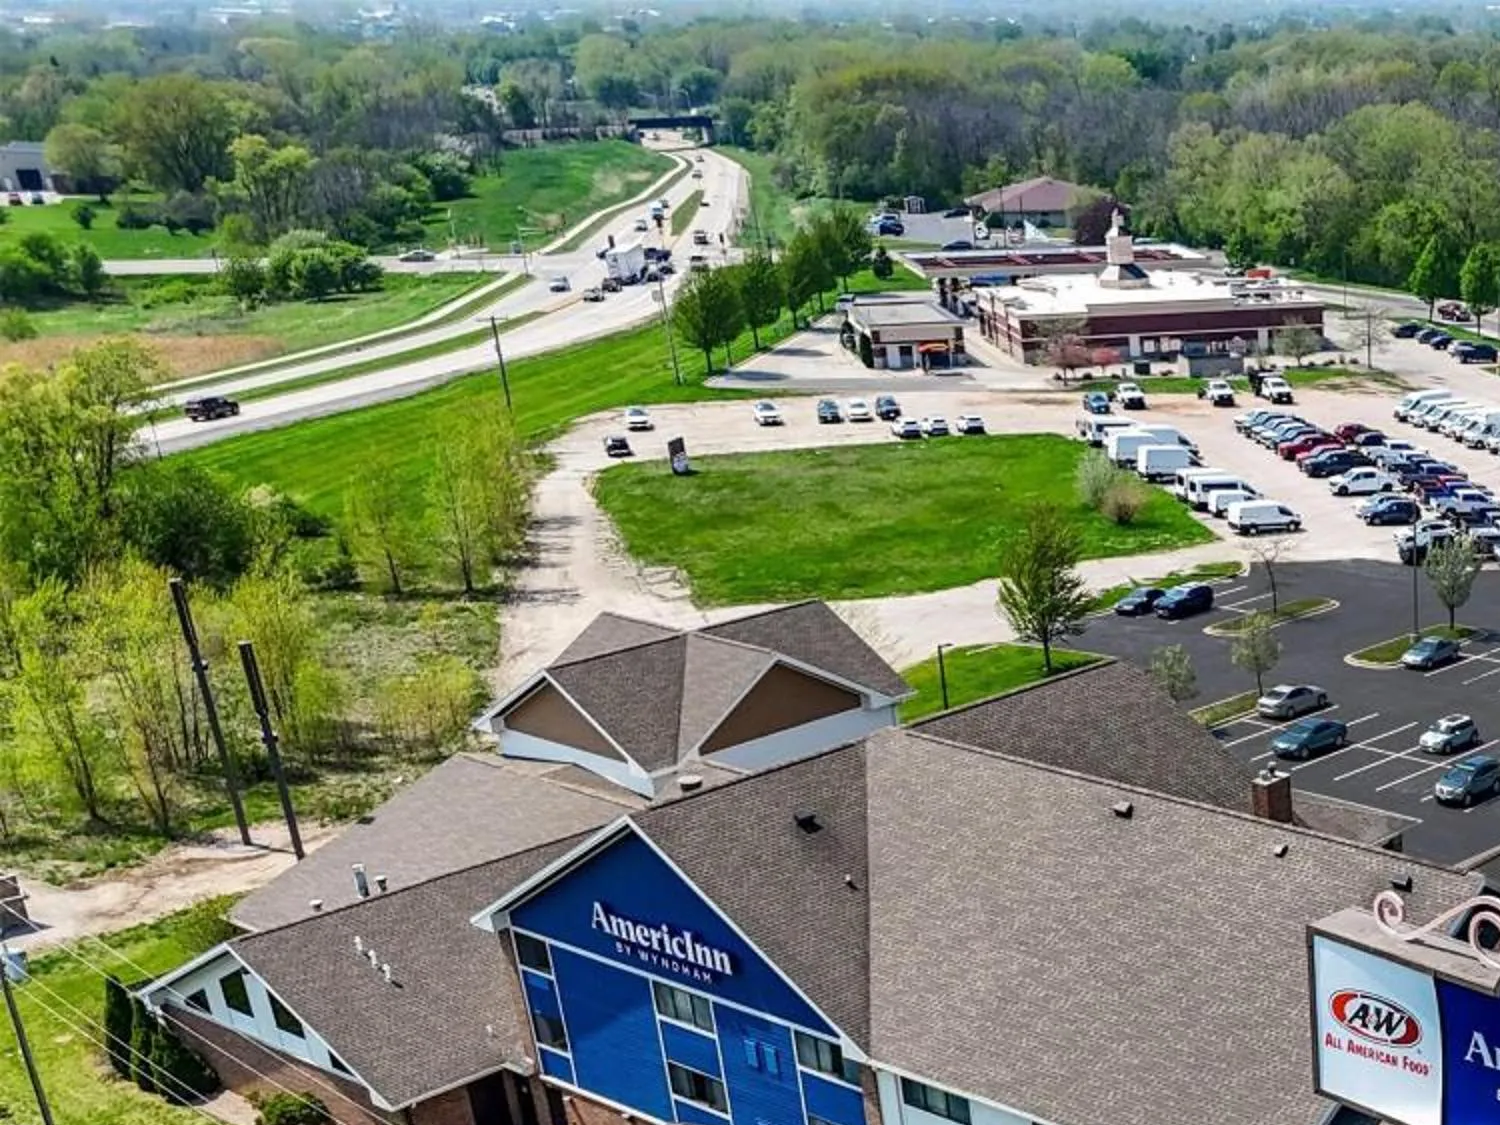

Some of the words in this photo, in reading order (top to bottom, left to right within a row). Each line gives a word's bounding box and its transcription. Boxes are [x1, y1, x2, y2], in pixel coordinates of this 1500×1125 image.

[591, 901, 733, 976] AmericInn
[615, 941, 631, 956] BY
[638, 950, 712, 983] WYNDHAM
